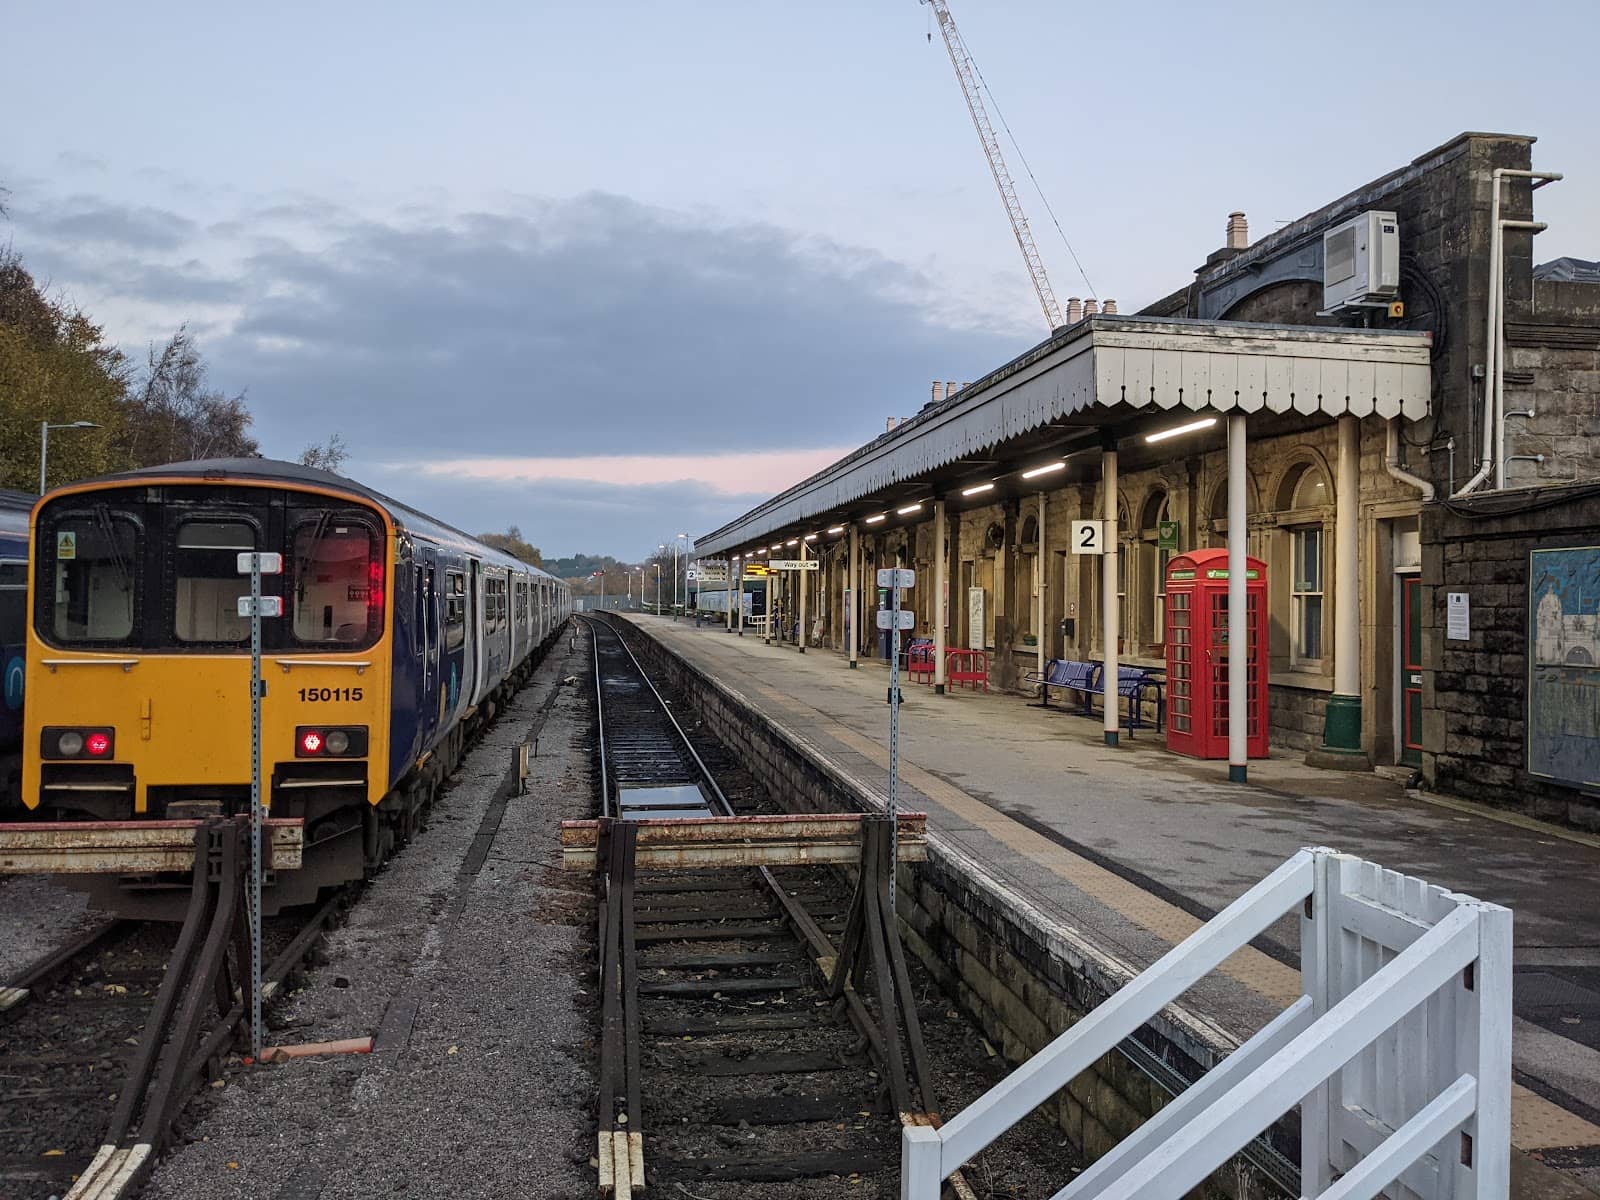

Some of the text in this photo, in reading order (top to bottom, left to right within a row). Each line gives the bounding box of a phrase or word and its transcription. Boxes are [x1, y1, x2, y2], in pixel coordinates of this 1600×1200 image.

[1080, 526, 1095, 547] 2
[784, 561, 797, 569] Way
[298, 688, 363, 702] 150115
